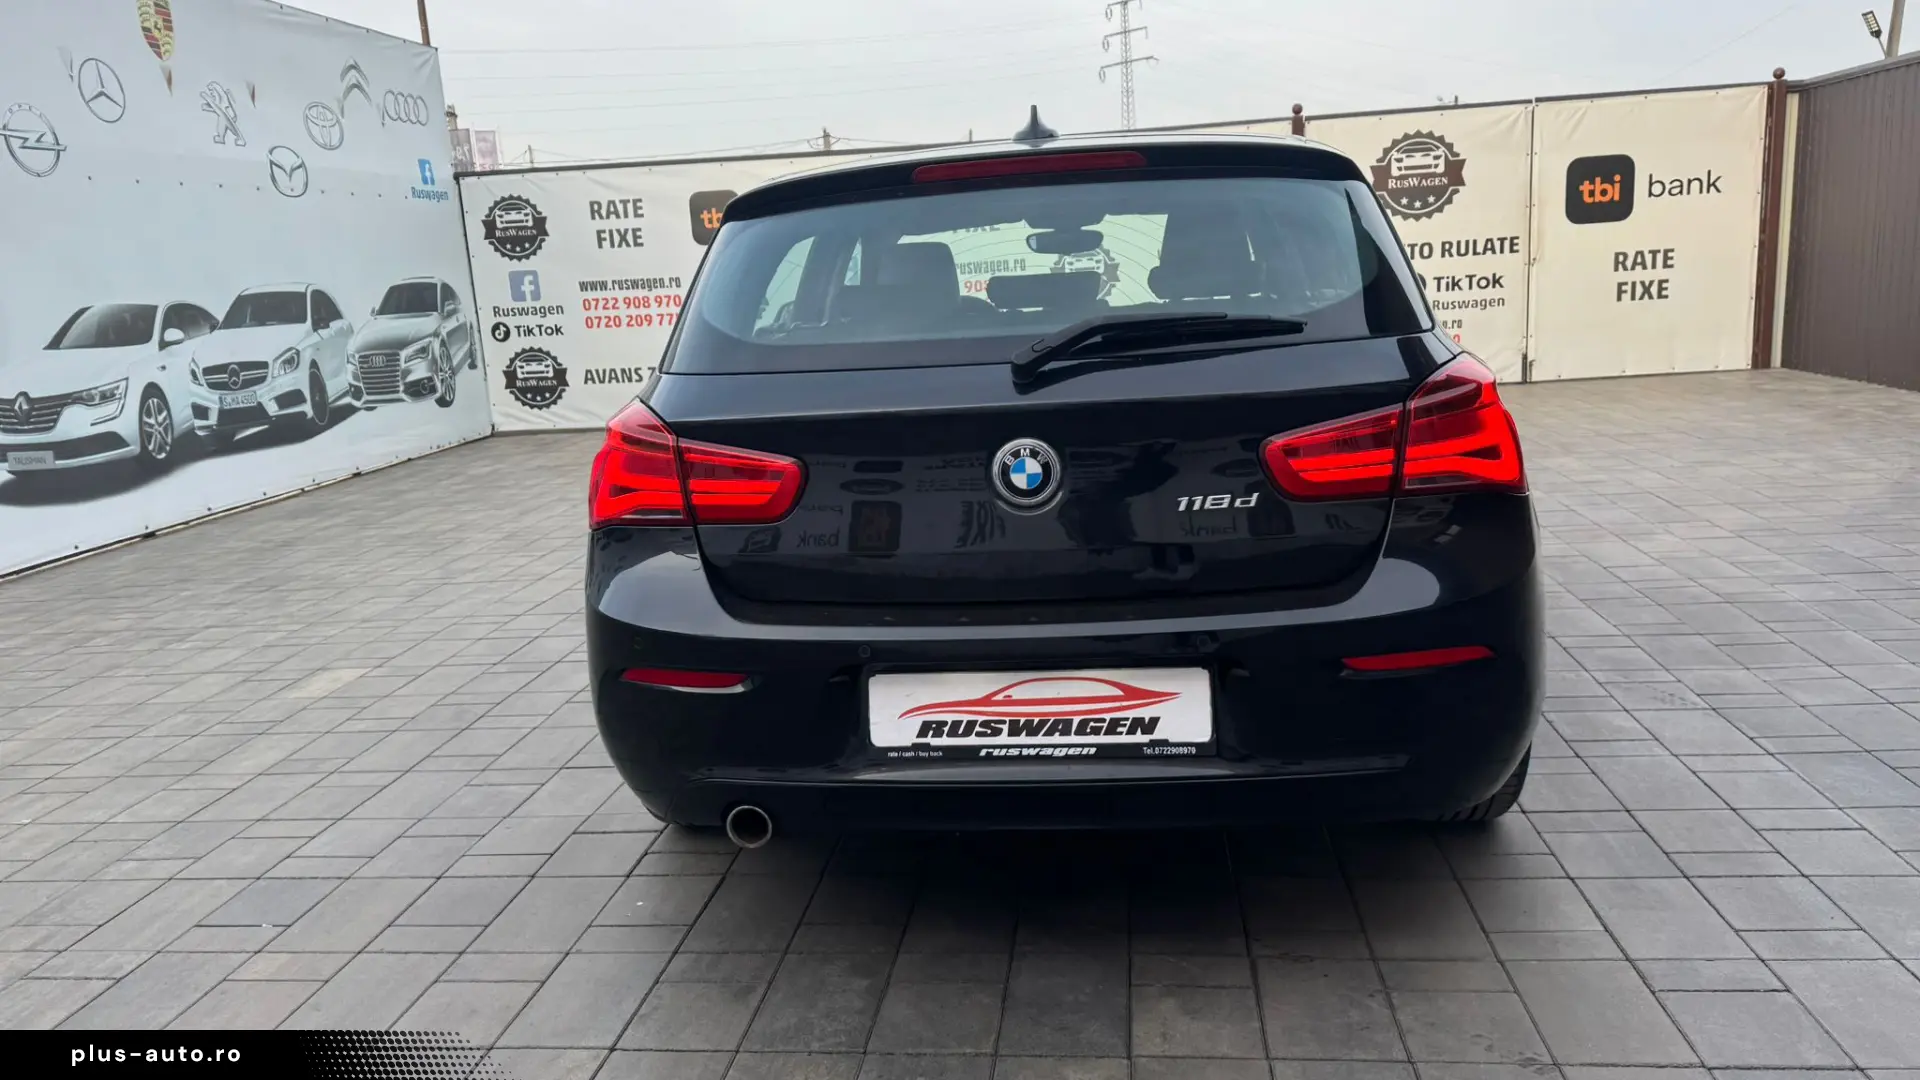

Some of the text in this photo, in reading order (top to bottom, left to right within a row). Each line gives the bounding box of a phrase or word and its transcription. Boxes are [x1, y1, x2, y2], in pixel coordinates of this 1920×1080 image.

[411, 186, 449, 203] Ruswagen
[1579, 169, 1723, 204] tbi bank
[589, 198, 645, 221] RATE
[700, 208, 723, 229] tb
[595, 227, 645, 250] FIXE
[1404, 236, 1520, 260] TO RULATE
[1613, 248, 1675, 272] RATE
[578, 276, 682, 293] www.ruswagen.ro
[1433, 272, 1505, 293] TikTok
[1616, 279, 1670, 302] FIXE
[492, 305, 564, 318] Ruswagen
[582, 294, 682, 311] 0722 908 970
[1433, 297, 1505, 311] Ruswagen
[514, 323, 564, 338] TikTok
[585, 315, 622, 329] 0720
[626, 313, 653, 327] 209
[583, 366, 644, 384] AVANS
[1004, 447, 1049, 466] BMW
[1176, 492, 1259, 511] 118d
[915, 715, 1161, 739] RUSWAGEN
[978, 745, 1098, 758] ruswagen
